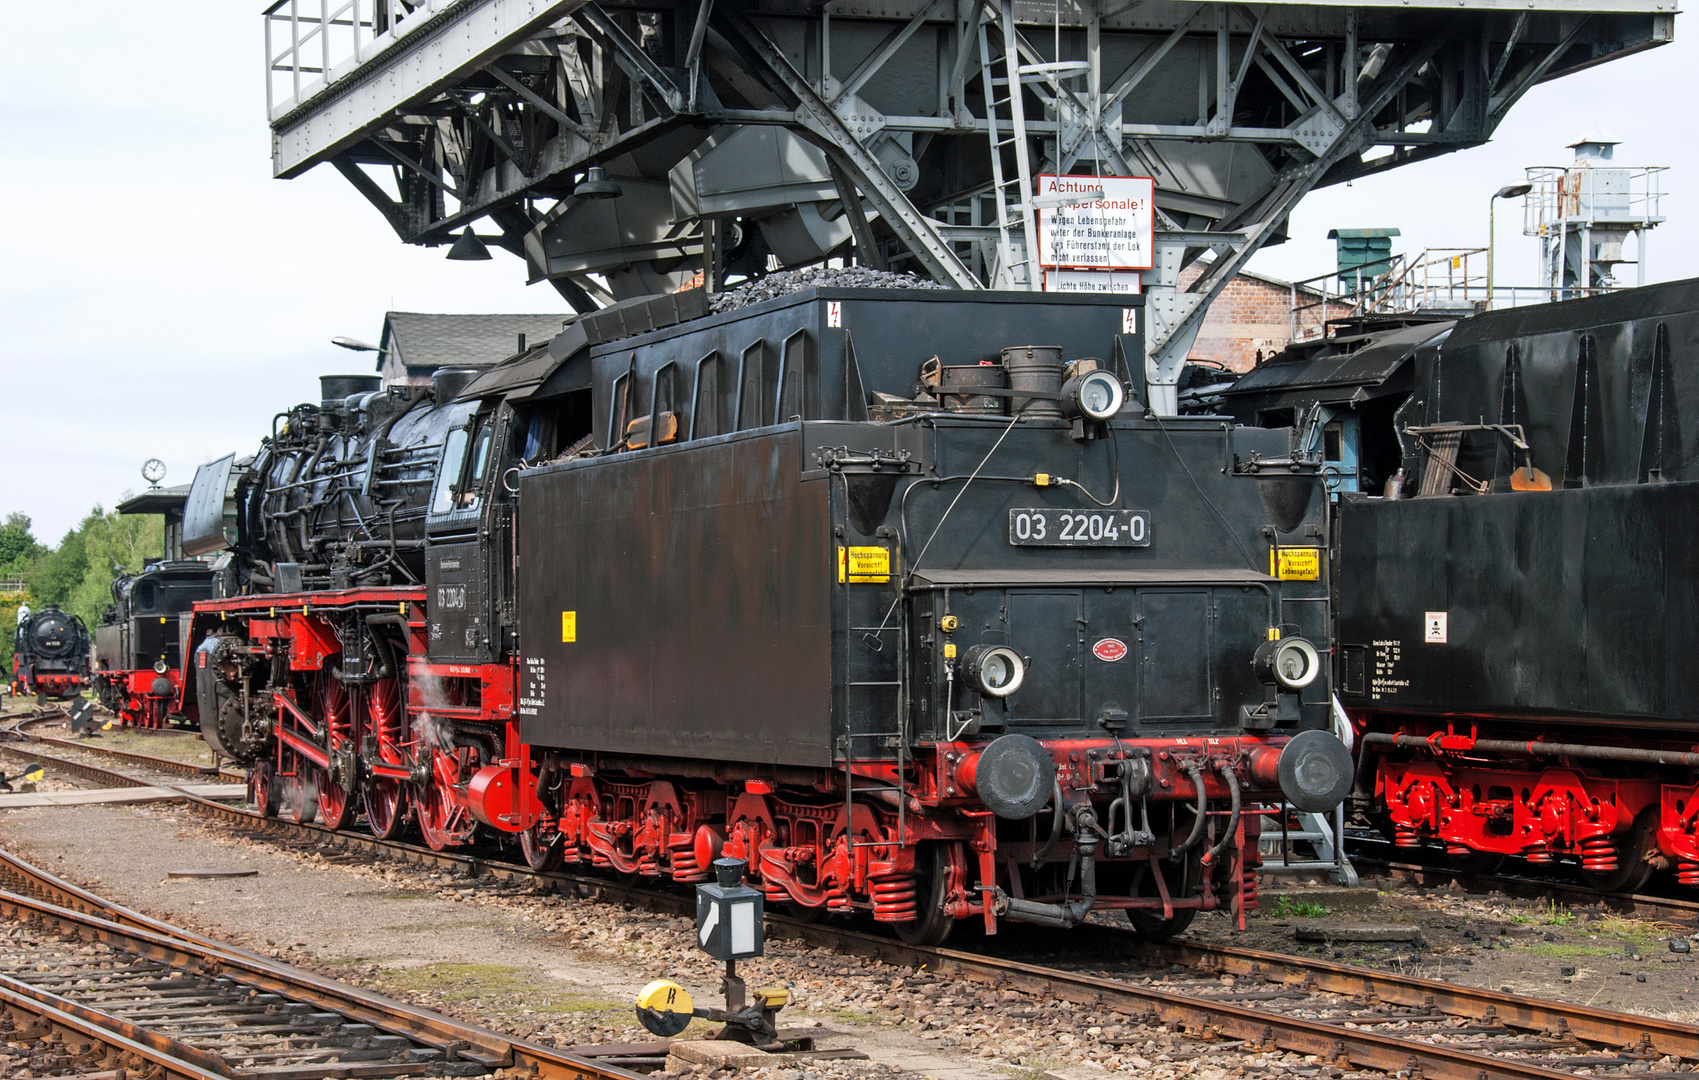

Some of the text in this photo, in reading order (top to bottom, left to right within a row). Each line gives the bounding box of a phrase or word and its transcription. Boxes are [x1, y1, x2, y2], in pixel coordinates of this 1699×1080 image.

[1073, 228, 1084, 237] der
[1087, 228, 1137, 240] Bunkeranlage
[1113, 241, 1125, 251] der
[1128, 241, 1141, 252] Lok
[1072, 253, 1107, 263] verlassen
[1079, 281, 1096, 291] Höhe
[1016, 513, 1145, 541] 03 2204-0
[437, 588, 446, 608] 03
[666, 987, 677, 1005] R
